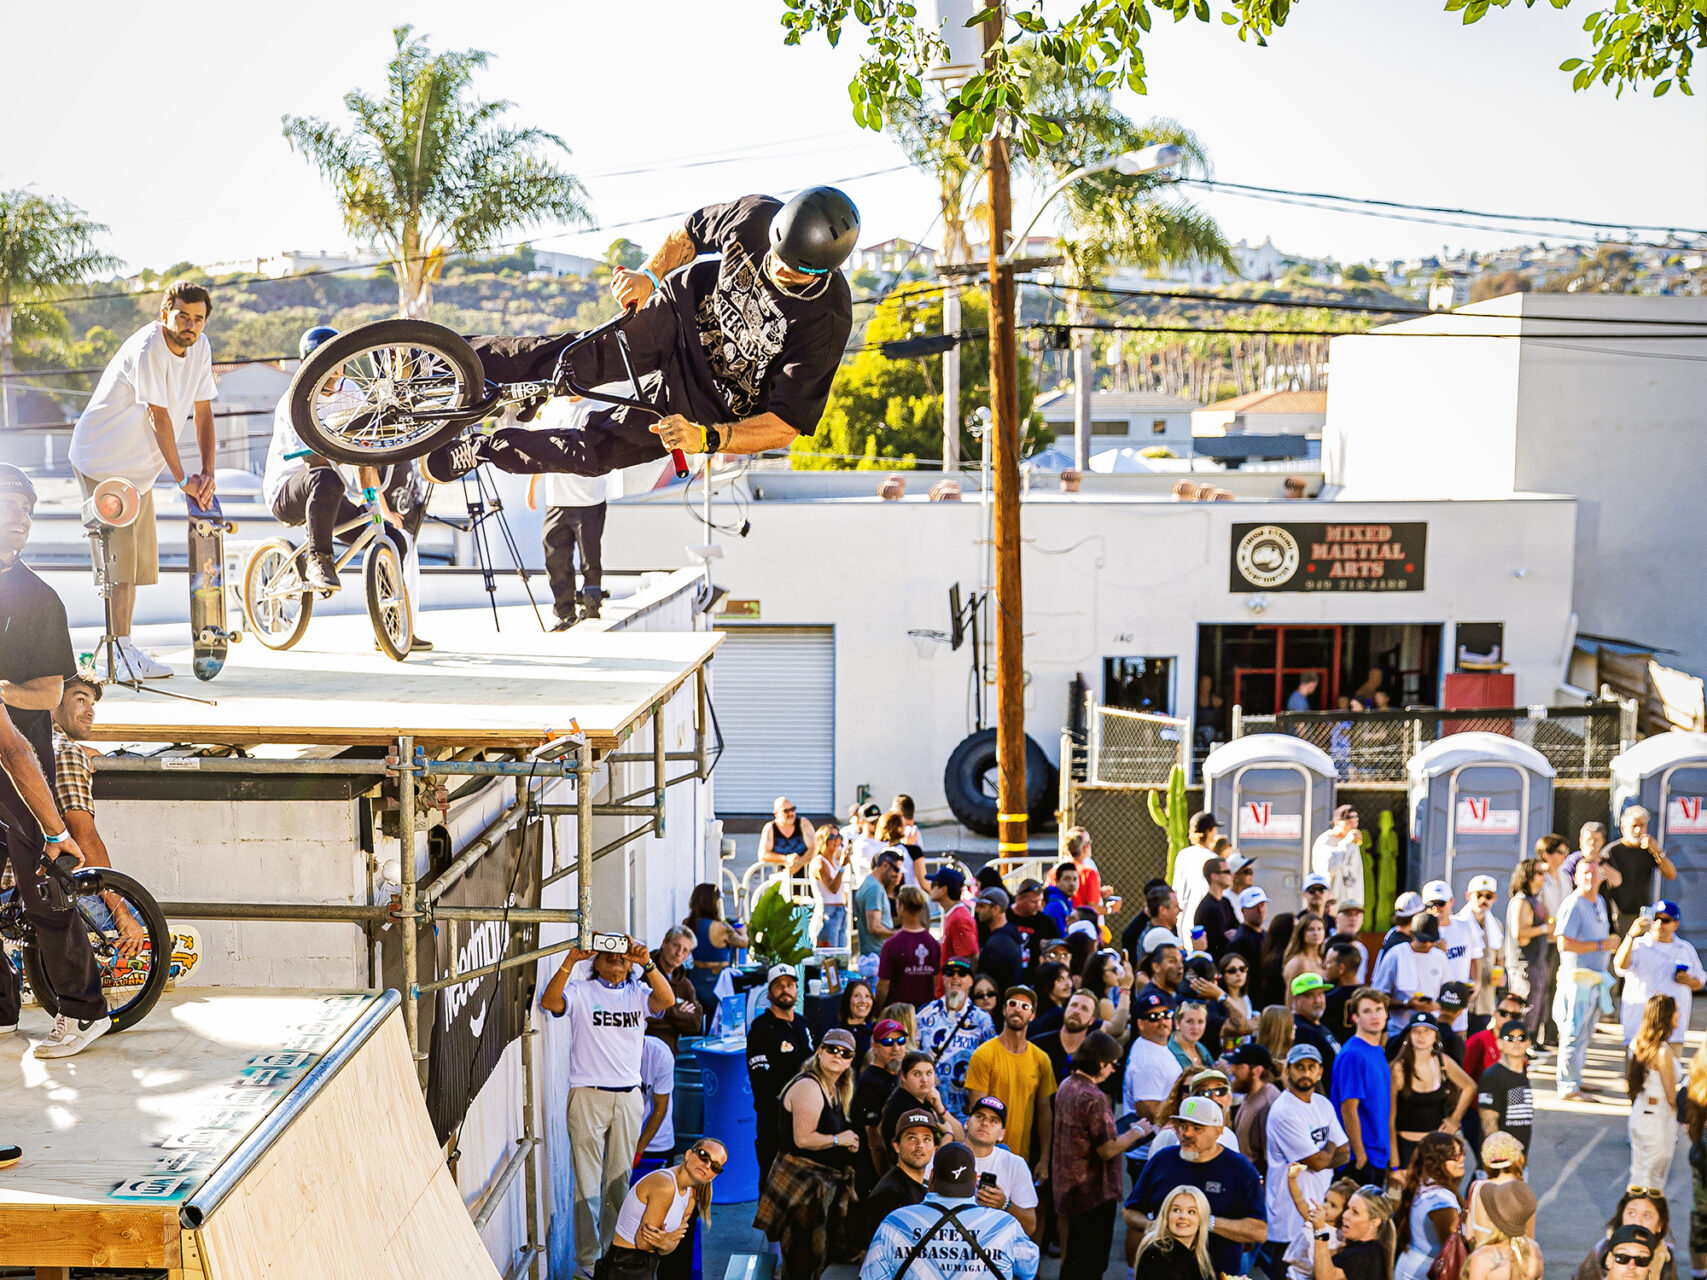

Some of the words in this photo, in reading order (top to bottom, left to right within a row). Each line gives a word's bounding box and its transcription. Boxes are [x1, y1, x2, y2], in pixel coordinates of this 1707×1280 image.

[1325, 525, 1392, 542] MIXED
[1311, 543, 1405, 560] MARTIAL
[1329, 561, 1384, 578] ARTS
[913, 1228, 981, 1241] SFEY
